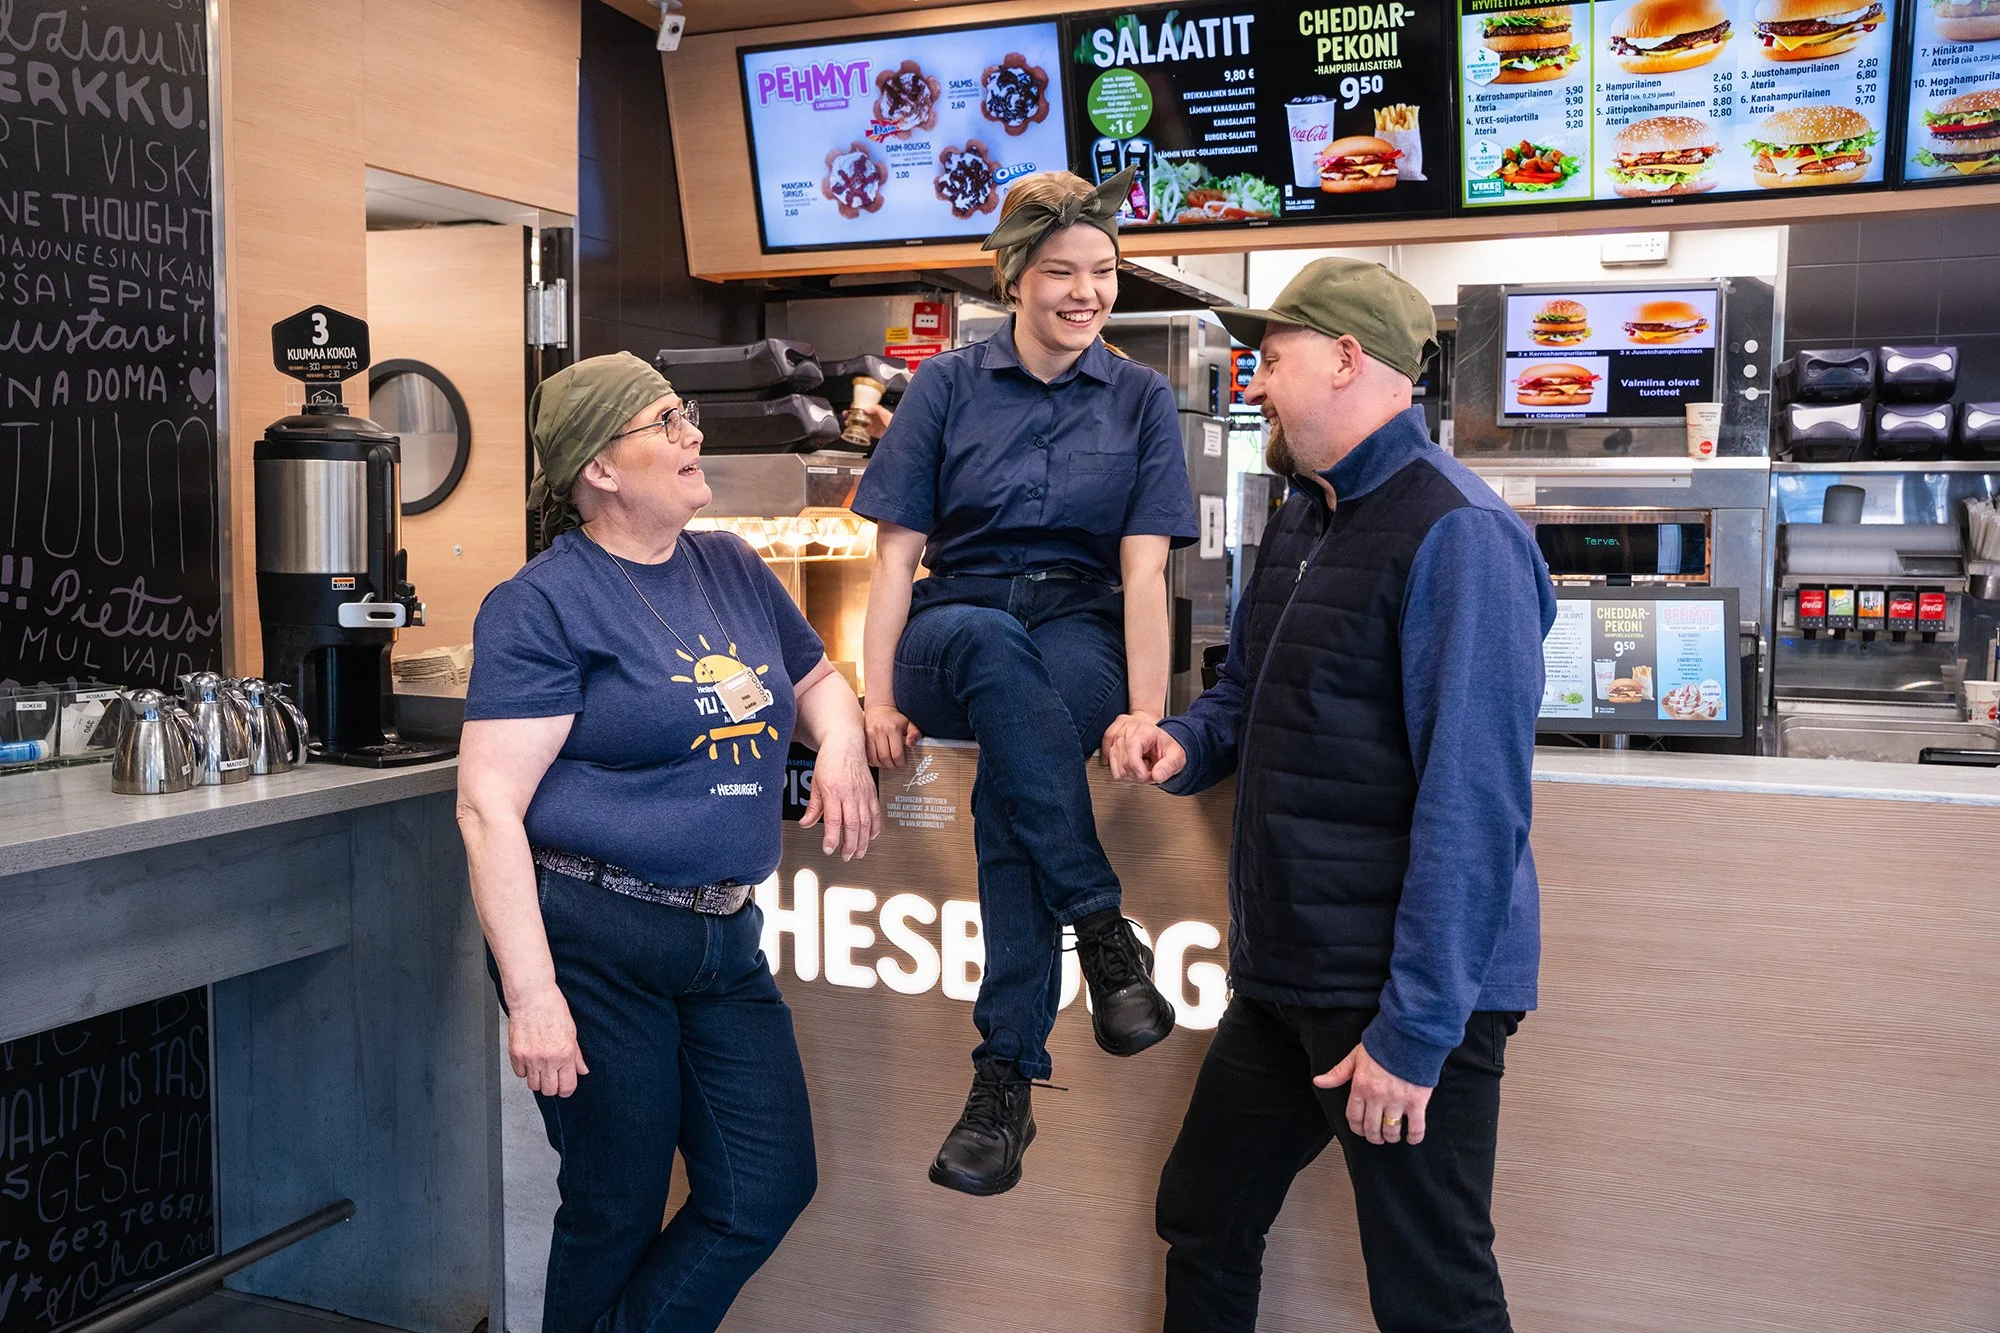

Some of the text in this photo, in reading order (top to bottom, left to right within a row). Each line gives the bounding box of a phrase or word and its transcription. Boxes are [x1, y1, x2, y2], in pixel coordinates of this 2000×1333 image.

[1299, 2, 1415, 36] CHEDDAR-
[1092, 14, 1255, 68] SALAATIT
[1317, 31, 1398, 62] PEKONI
[1932, 44, 1974, 56] Minikana
[1314, 58, 1402, 75] -HAMPURILAISATERIA
[1752, 63, 1840, 78] Juustohampurilainen
[1858, 58, 1878, 69] 2,80
[1931, 56, 1960, 66] Ateria
[1224, 68, 1255, 82] 9,80 €
[1606, 80, 1662, 91] Hampurilainen
[1713, 72, 1732, 82] 2,40
[1750, 70, 1877, 89] Ateria 6,80
[758, 61, 871, 105] PEHMYT
[949, 79, 973, 89] SALMIS
[1913, 79, 1927, 88] 10.
[1183, 87, 1255, 100] KREIKKALAINEN SALAATTI
[1475, 89, 1553, 102] Kerroshampurilainen
[1565, 85, 1583, 95] 5,90
[1606, 93, 1629, 102] Ateria
[1713, 84, 1732, 93] 5,60
[1751, 89, 1831, 103] Kanahampurilainen
[1856, 83, 1876, 94] 5,70
[1929, 87, 1957, 97] Ateria
[951, 101, 966, 110] 2,60
[1189, 102, 1255, 115] LÄMMIN KANASALAATTI
[1474, 96, 1583, 112] Ateria 9,90
[1606, 100, 1705, 115] Jättipekonihampurilainen
[1713, 96, 1732, 106] 8,80
[1749, 95, 1876, 114] Ateria 9,70
[1213, 116, 1256, 127] KANASALAATTI
[1475, 113, 1539, 124] VEKE-soijatortilla
[1566, 109, 1583, 118] 5,20
[1606, 108, 1732, 126] Ateria 12,80
[1126, 120, 1133, 133] €
[1474, 120, 1583, 135] Ateria 9,20
[1204, 131, 1256, 141] BURGER-SALAATTI
[886, 141, 931, 152] DAIM-ROUSKIS
[101, 133, 211, 199] VISK
[995, 163, 1035, 180] OREO
[896, 171, 910, 179] 3,00
[781, 181, 815, 190] MANSIKKA-
[783, 190, 804, 198] SIRKUS
[785, 209, 799, 217] 2,60
[51, 193, 212, 256] THOUGHT
[0, 234, 151, 278] AJONEESIN
[311, 312, 330, 346] 3
[287, 347, 357, 361] KUUMAA KOKOA
[1620, 378, 1700, 388] Valmiina olevat
[1639, 388, 1680, 397] tuotteet
[1596, 607, 1650, 620] CHEDDAR-
[1604, 620, 1642, 633] PEKONI
[716, 782, 759, 798] HESBURGER
[120, 1051, 143, 1109] IS
